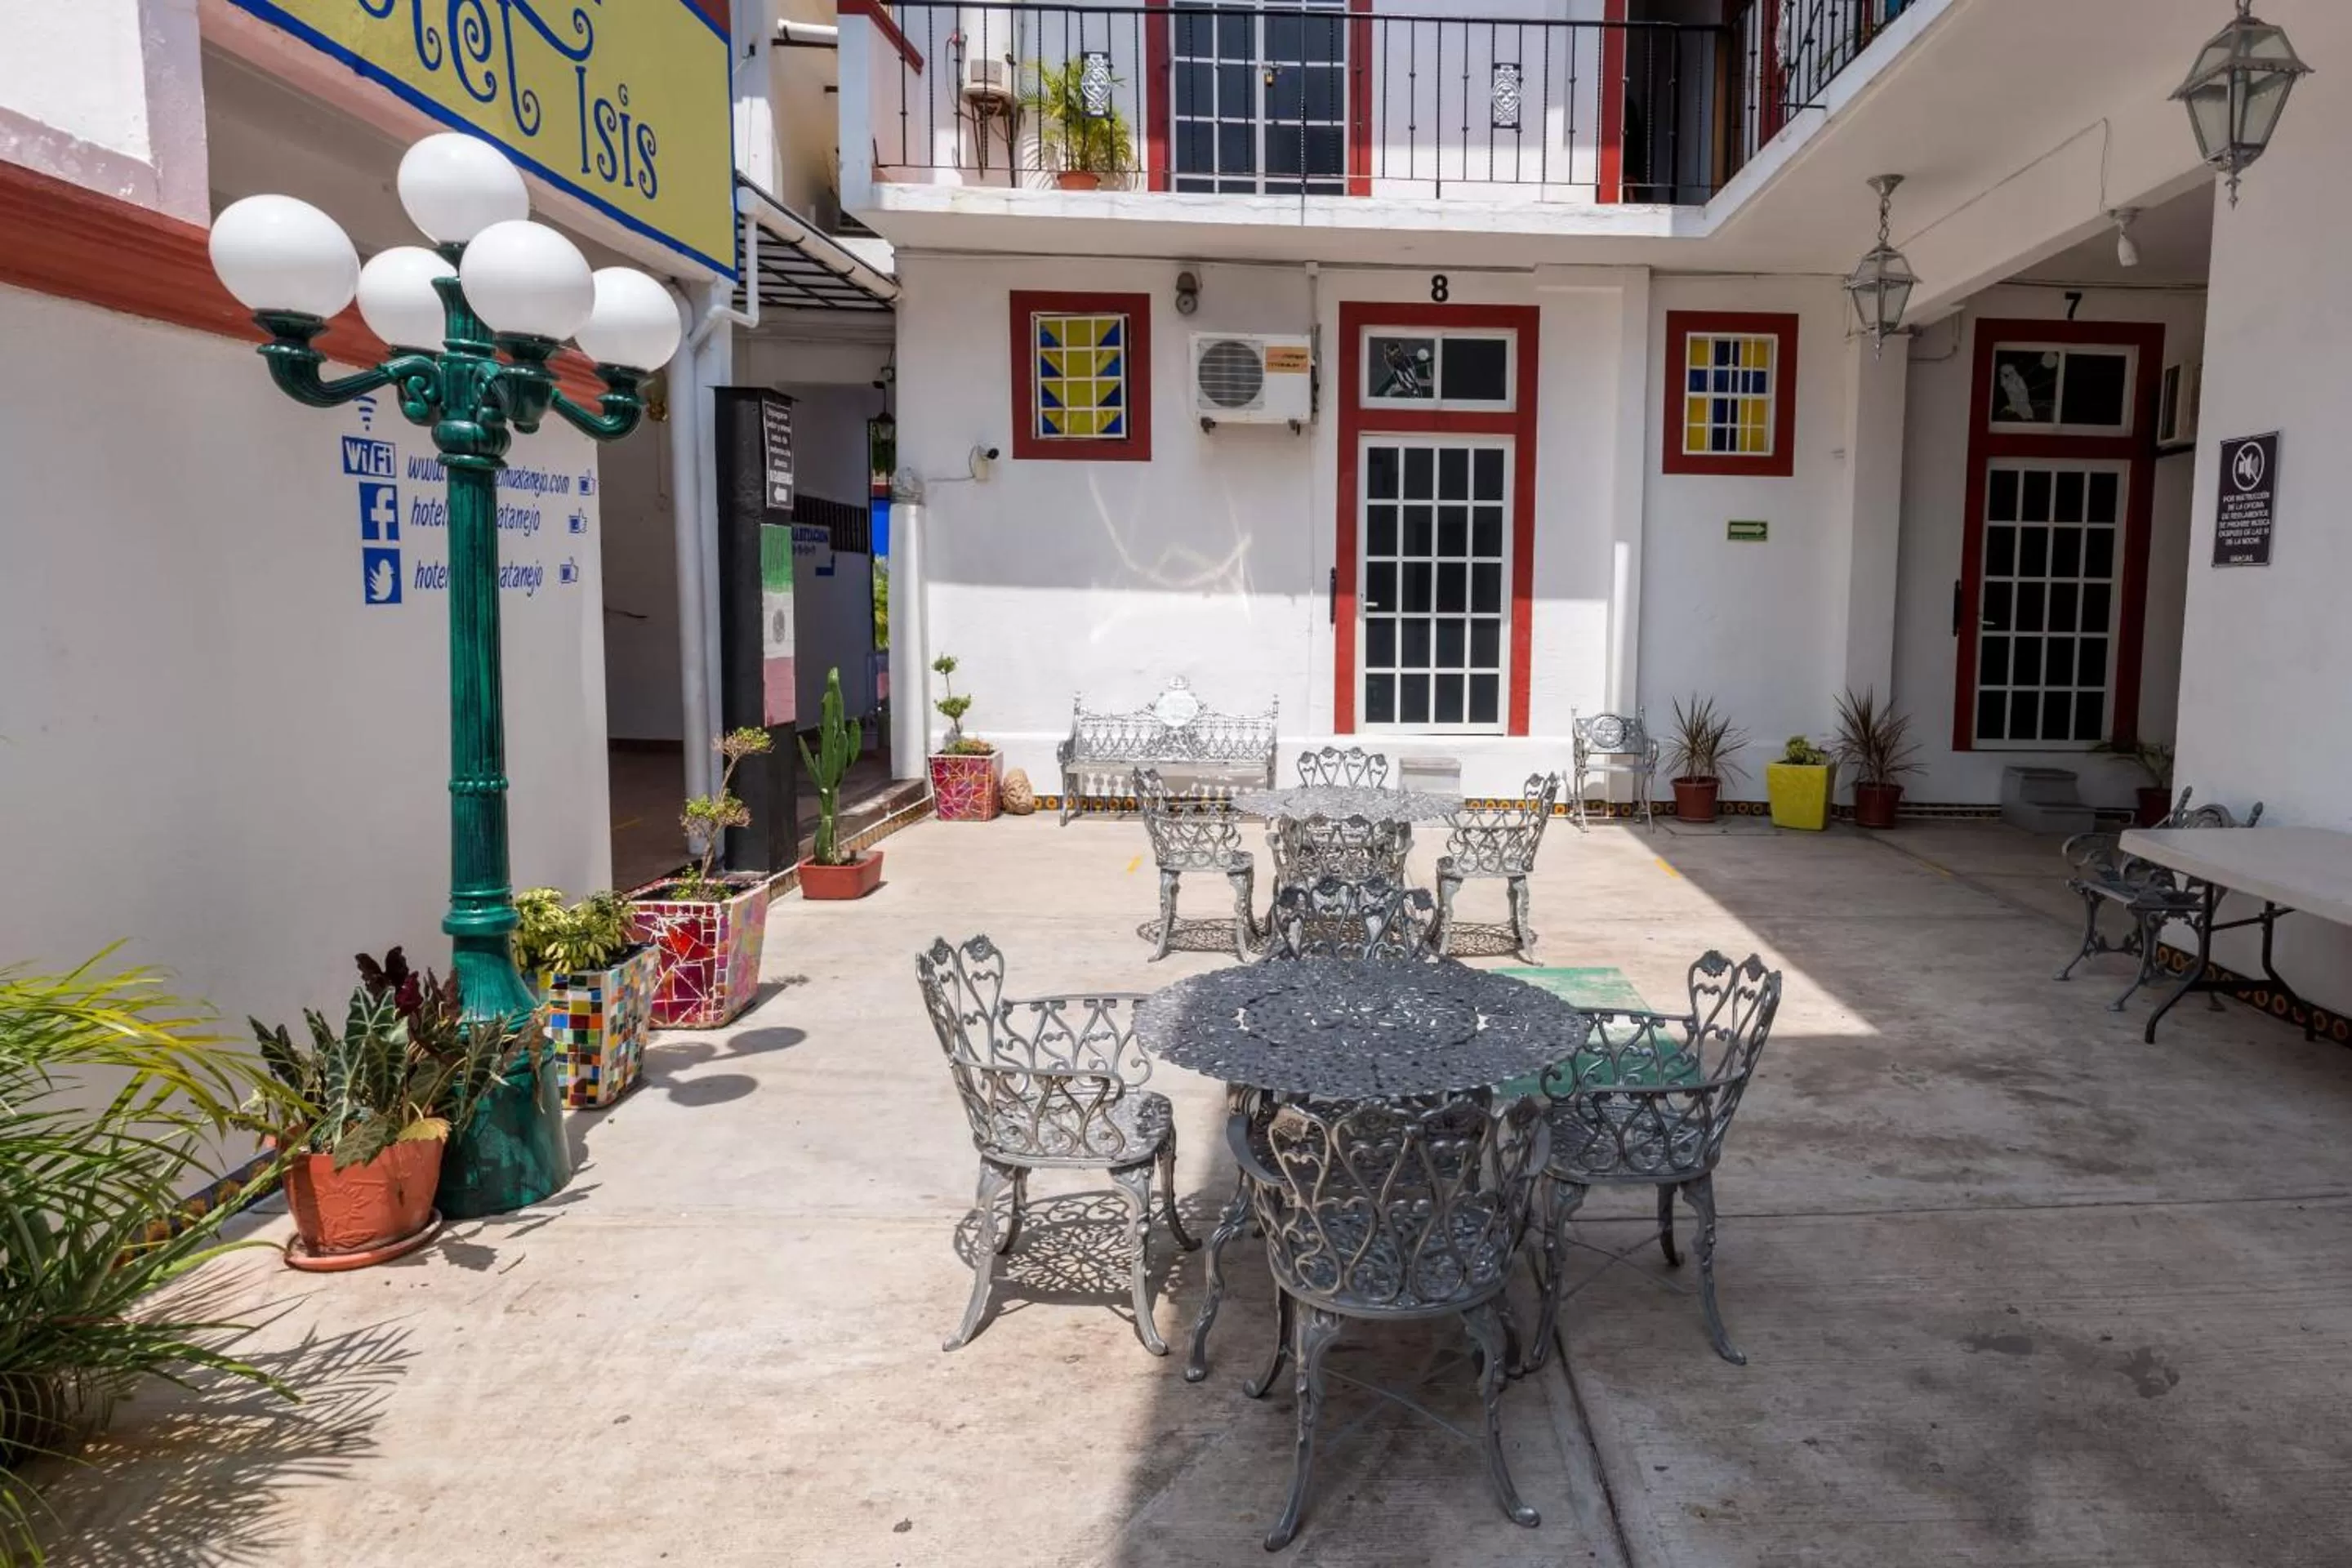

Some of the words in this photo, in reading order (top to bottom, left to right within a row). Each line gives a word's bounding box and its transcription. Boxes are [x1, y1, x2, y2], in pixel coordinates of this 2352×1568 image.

[575, 66, 658, 199] Isis
[1431, 274, 1449, 302] 8
[2065, 292, 2082, 320] 7
[344, 439, 392, 474] WiFi
